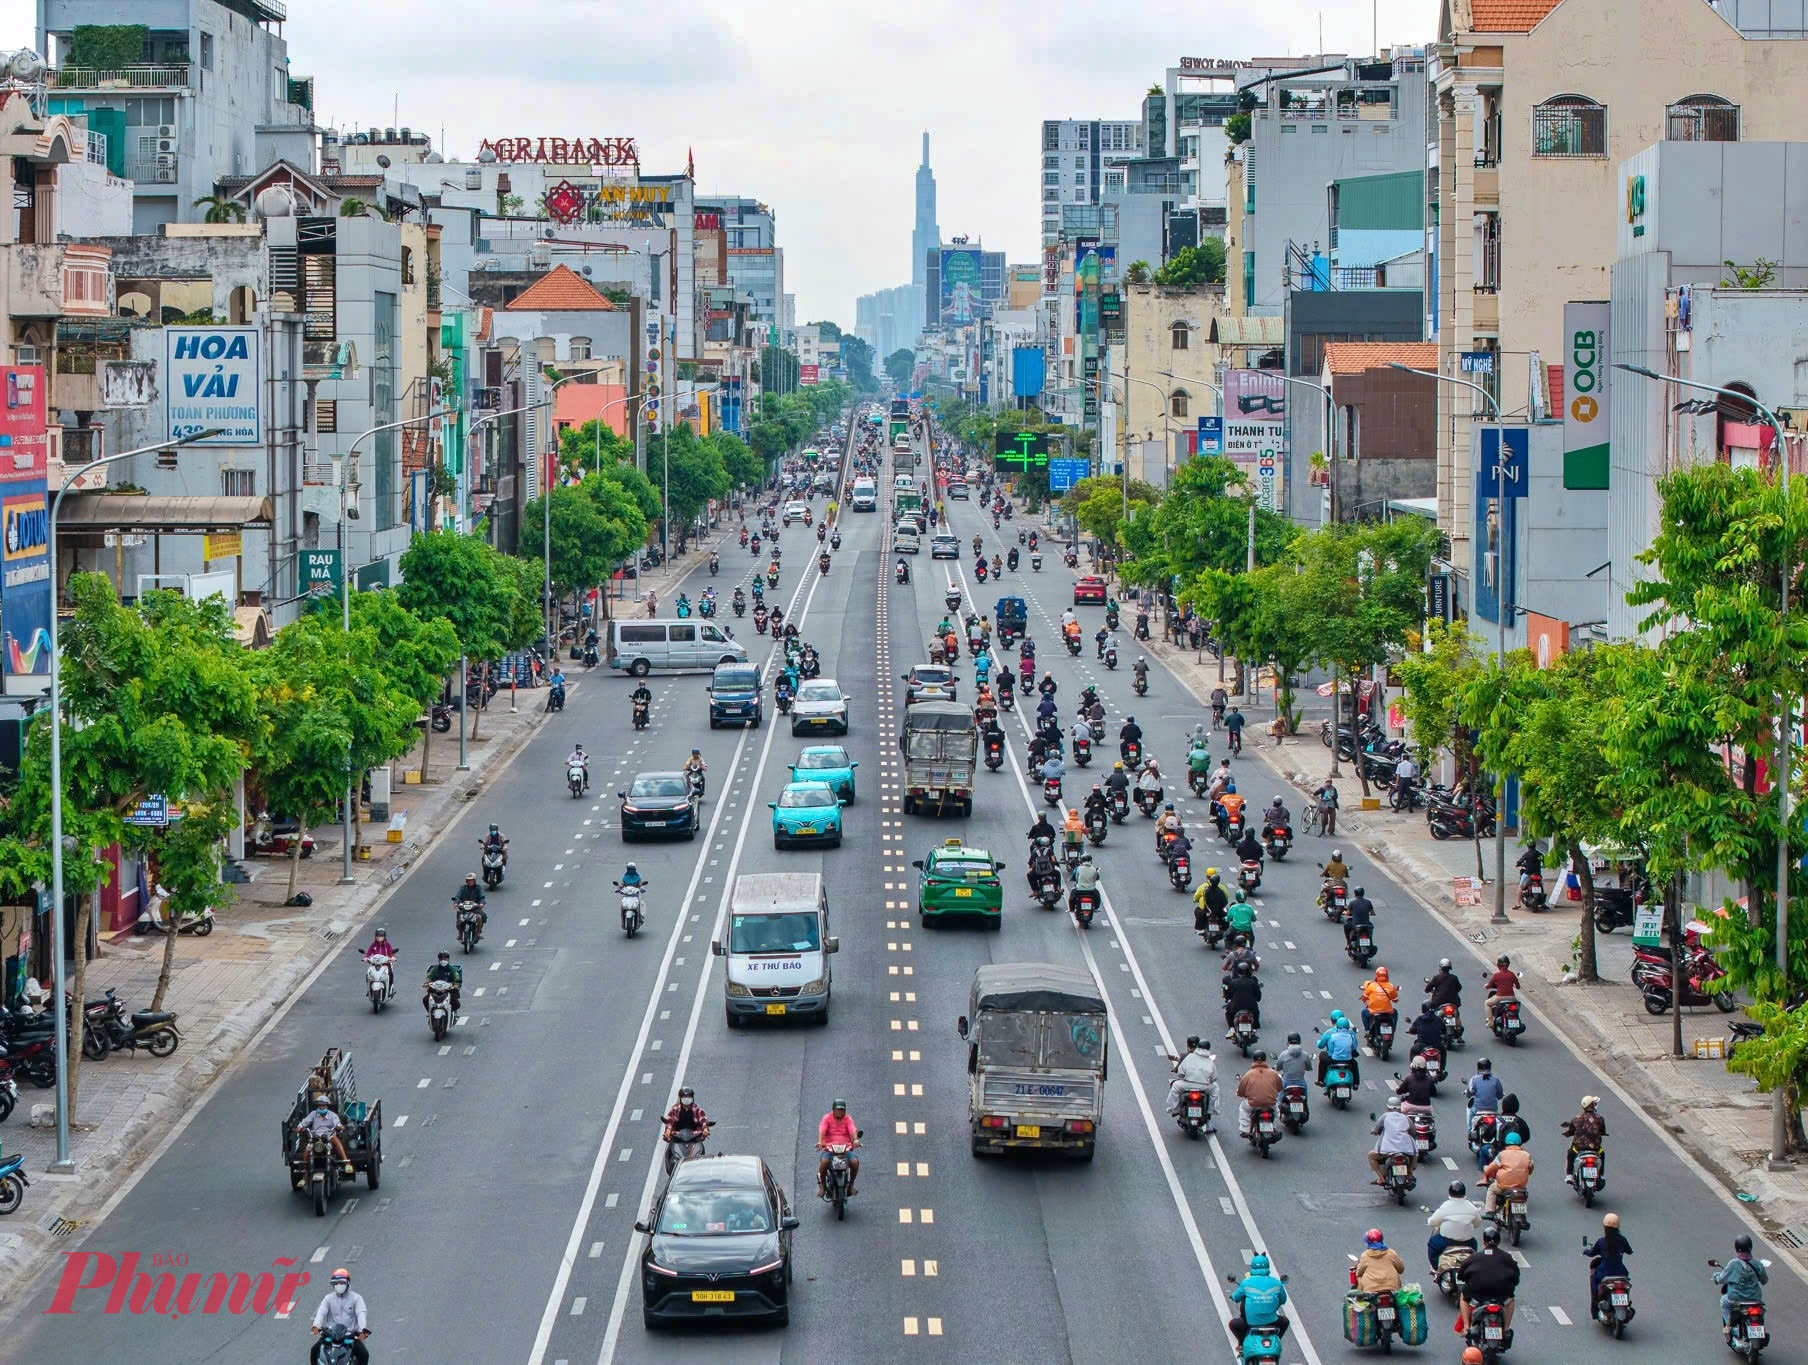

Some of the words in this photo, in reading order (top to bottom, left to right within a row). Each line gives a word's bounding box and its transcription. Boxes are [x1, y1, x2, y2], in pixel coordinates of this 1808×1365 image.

[475, 137, 637, 161] AGRIBANK
[600, 187, 627, 203] AN
[630, 187, 670, 203] HUY
[1048, 254, 1056, 292] HOTEL
[174, 335, 249, 360] HOA
[1461, 355, 1473, 371] MỸ
[1473, 355, 1494, 373] NGHỆ
[1574, 330, 1596, 393] OCB
[1597, 364, 1605, 379] Hàng
[183, 364, 240, 398] VẢI
[1597, 379, 1605, 393] Ngân
[207, 405, 256, 420] PHƯƠNG
[1228, 426, 1265, 437] THANH
[1268, 426, 1284, 437] TU
[1228, 440, 1245, 450] ĐIỆN
[1247, 440, 1252, 449] Ô
[1491, 465, 1520, 484] PNJ
[309, 555, 333, 565] RAU
[311, 565, 331, 578] MÁ
[747, 962, 759, 971] XE
[762, 961, 780, 971] THƯ
[782, 960, 802, 970] BÁO
